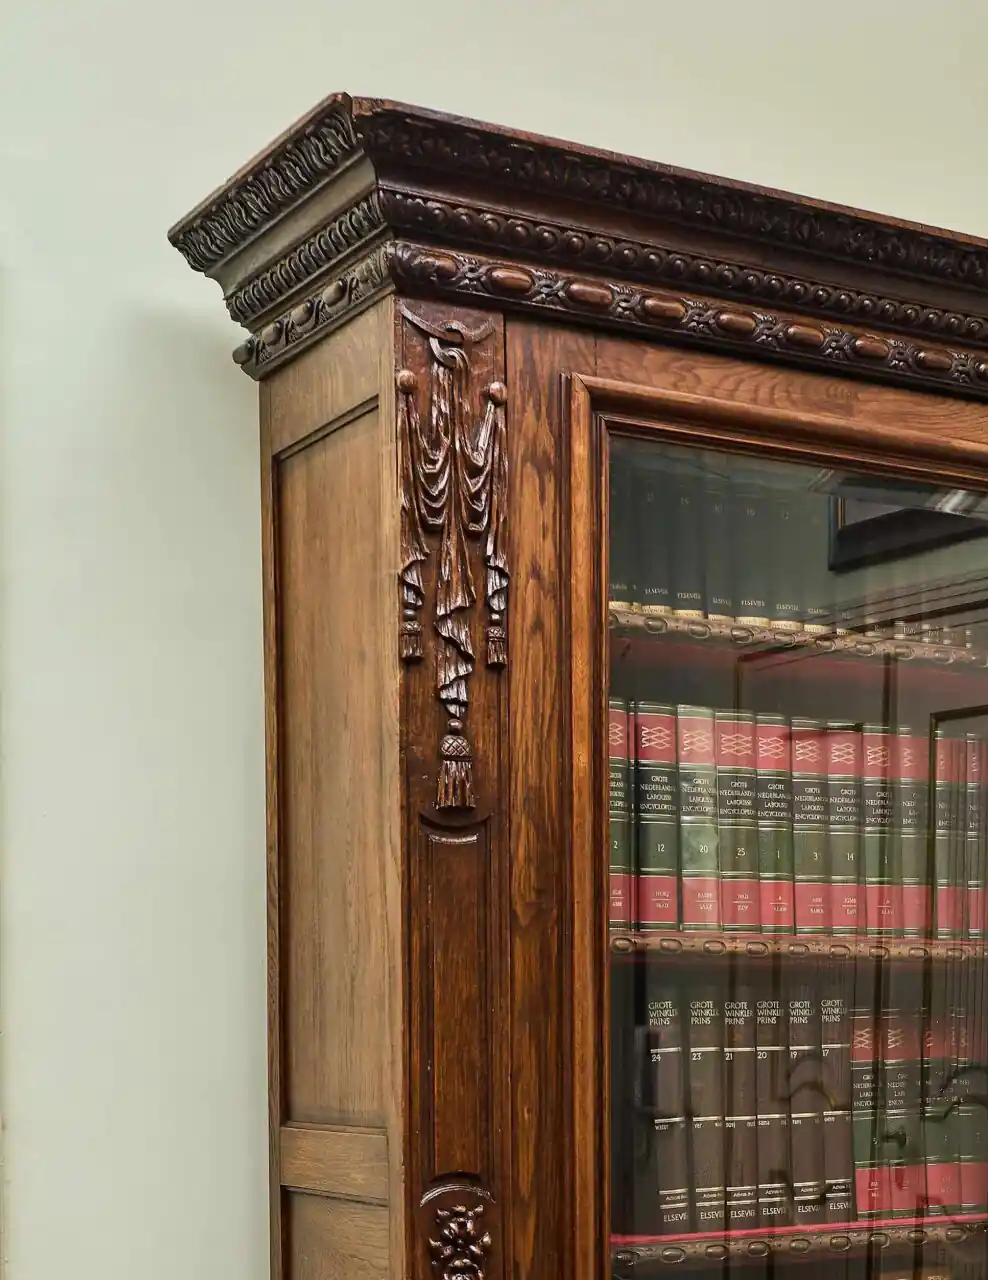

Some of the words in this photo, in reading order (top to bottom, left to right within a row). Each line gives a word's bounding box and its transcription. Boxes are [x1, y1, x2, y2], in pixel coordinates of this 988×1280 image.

[613, 840, 618, 848] 2
[657, 844, 664, 852] 12
[700, 844, 708, 853] 20
[737, 848, 746, 856] 25
[777, 850, 780, 858] 1
[813, 852, 818, 860] 3
[847, 852, 854, 860] 14
[648, 1001, 672, 1010] GROTE
[649, 1018, 670, 1026] PRINS
[652, 1054, 661, 1062] 24
[790, 1051, 797, 1059] 19
